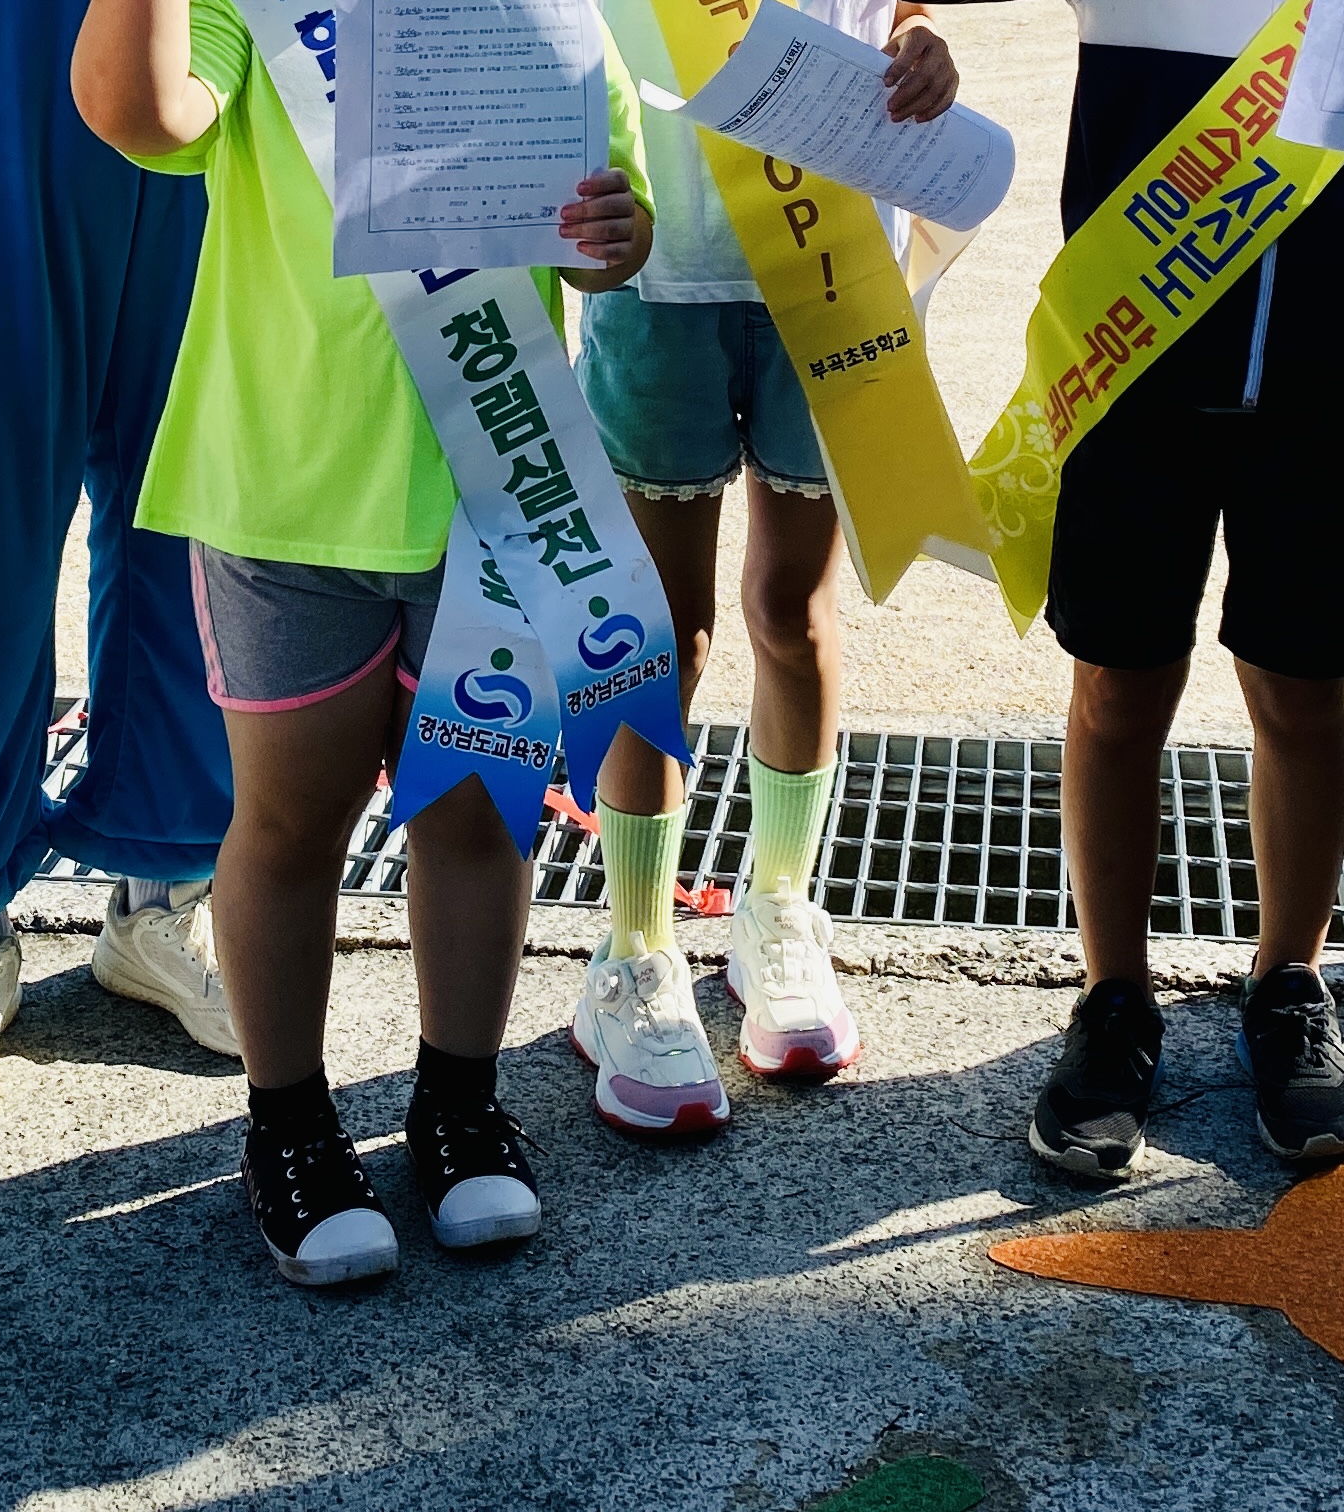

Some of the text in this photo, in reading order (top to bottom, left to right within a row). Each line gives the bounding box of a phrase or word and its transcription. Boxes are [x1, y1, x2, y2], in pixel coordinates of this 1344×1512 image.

[808, 327, 911, 382] 부곡초등학교
[440, 298, 614, 587] 청렴실천
[567, 652, 671, 714] 경상남도교육청
[418, 715, 551, 769] 경상남도교육청
